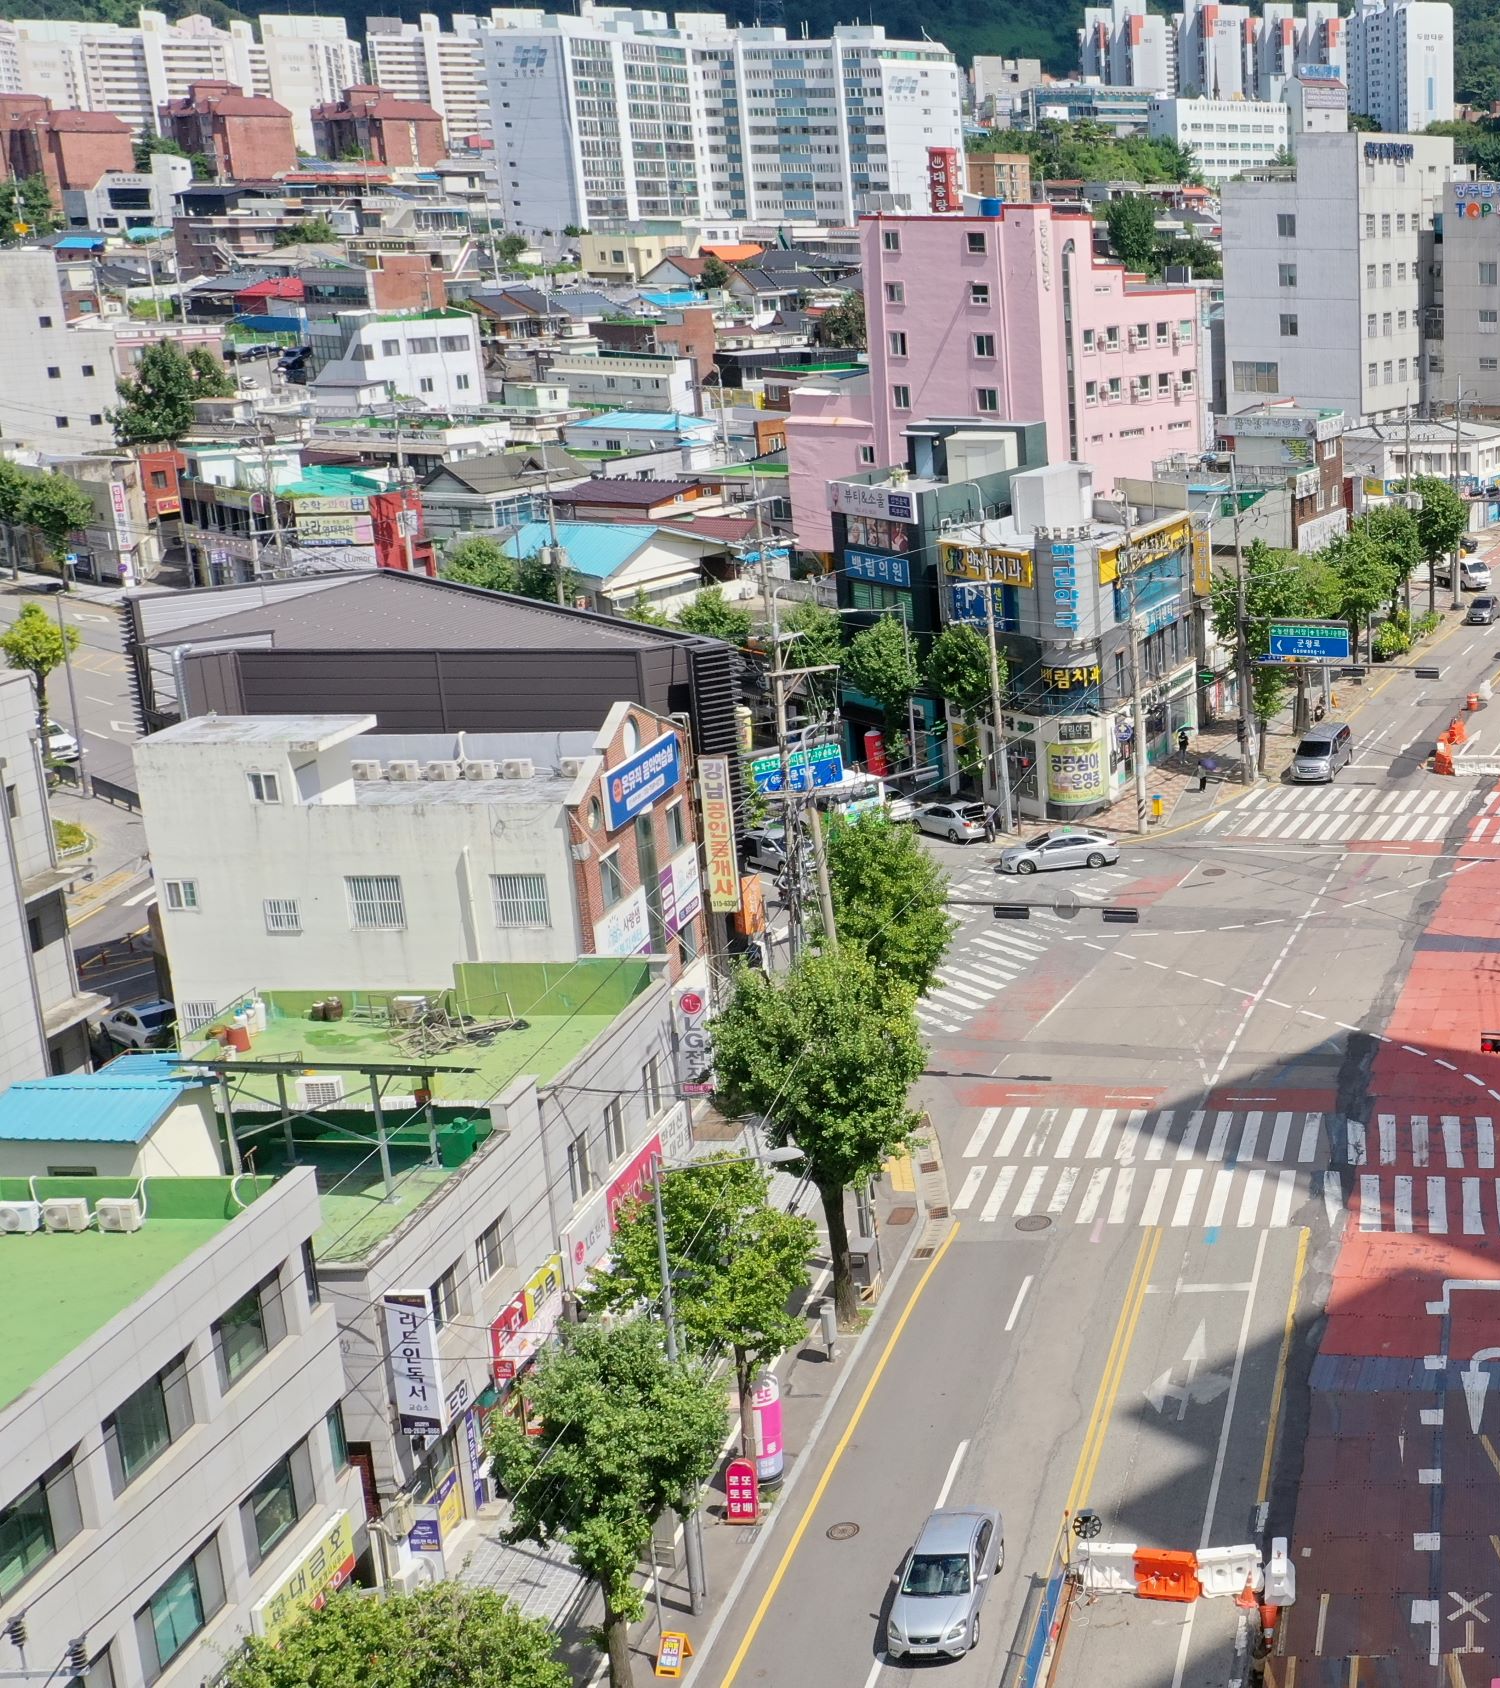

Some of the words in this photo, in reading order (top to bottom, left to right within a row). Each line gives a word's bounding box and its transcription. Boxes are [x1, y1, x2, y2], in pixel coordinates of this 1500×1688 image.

[933, 171, 949, 212] 대중탕
[1456, 203, 1492, 220] TOP
[851, 554, 903, 583] 백림의원
[1051, 544, 1079, 631] 백림약국
[1297, 640, 1321, 649] 군왕로
[1041, 666, 1101, 690] 백림치과
[1051, 753, 1100, 773] 공공심야
[1072, 770, 1100, 791] 운영중
[703, 761, 734, 896] 강남공인중개사
[623, 907, 641, 932] 사랑샘
[409, 1403, 429, 1412] 교습소
[730, 1502, 754, 1514] 담배
